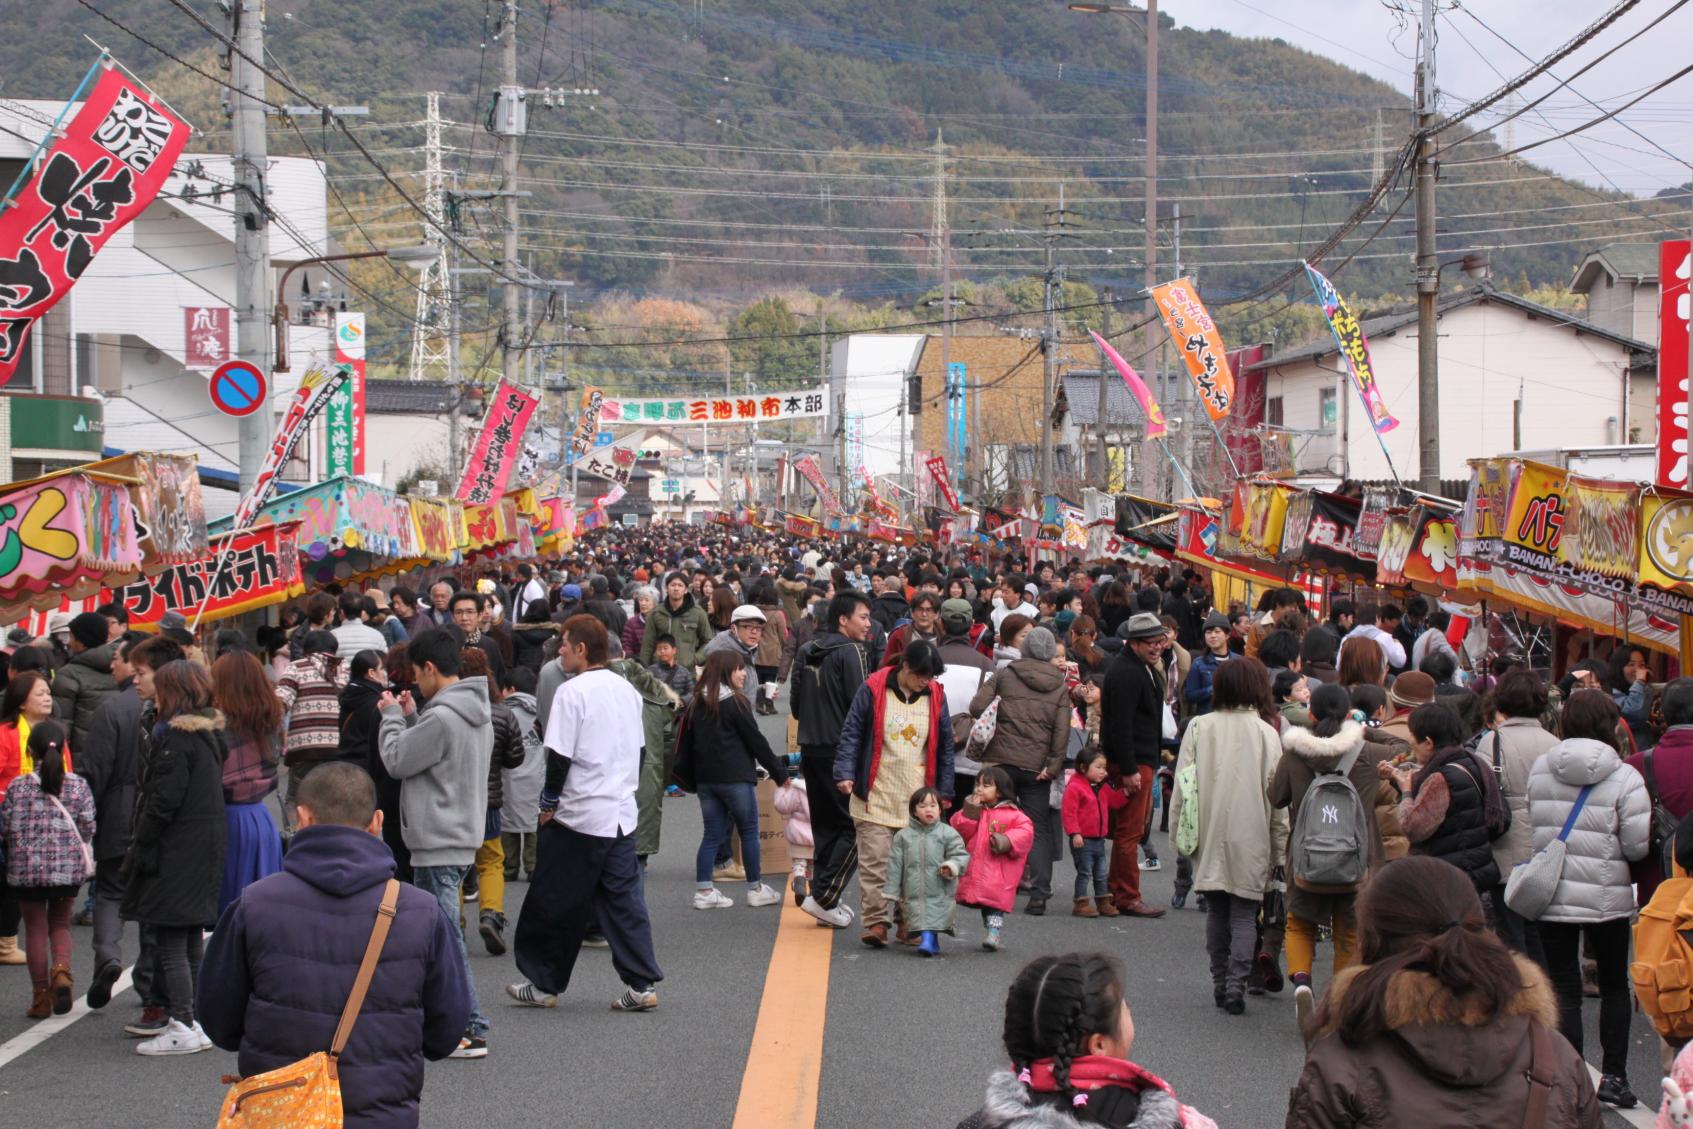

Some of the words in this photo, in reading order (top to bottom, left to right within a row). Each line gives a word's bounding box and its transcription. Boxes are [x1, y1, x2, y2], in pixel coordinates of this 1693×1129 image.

[92, 88, 172, 173] こだわり
[587, 458, 630, 484] たこ焼
